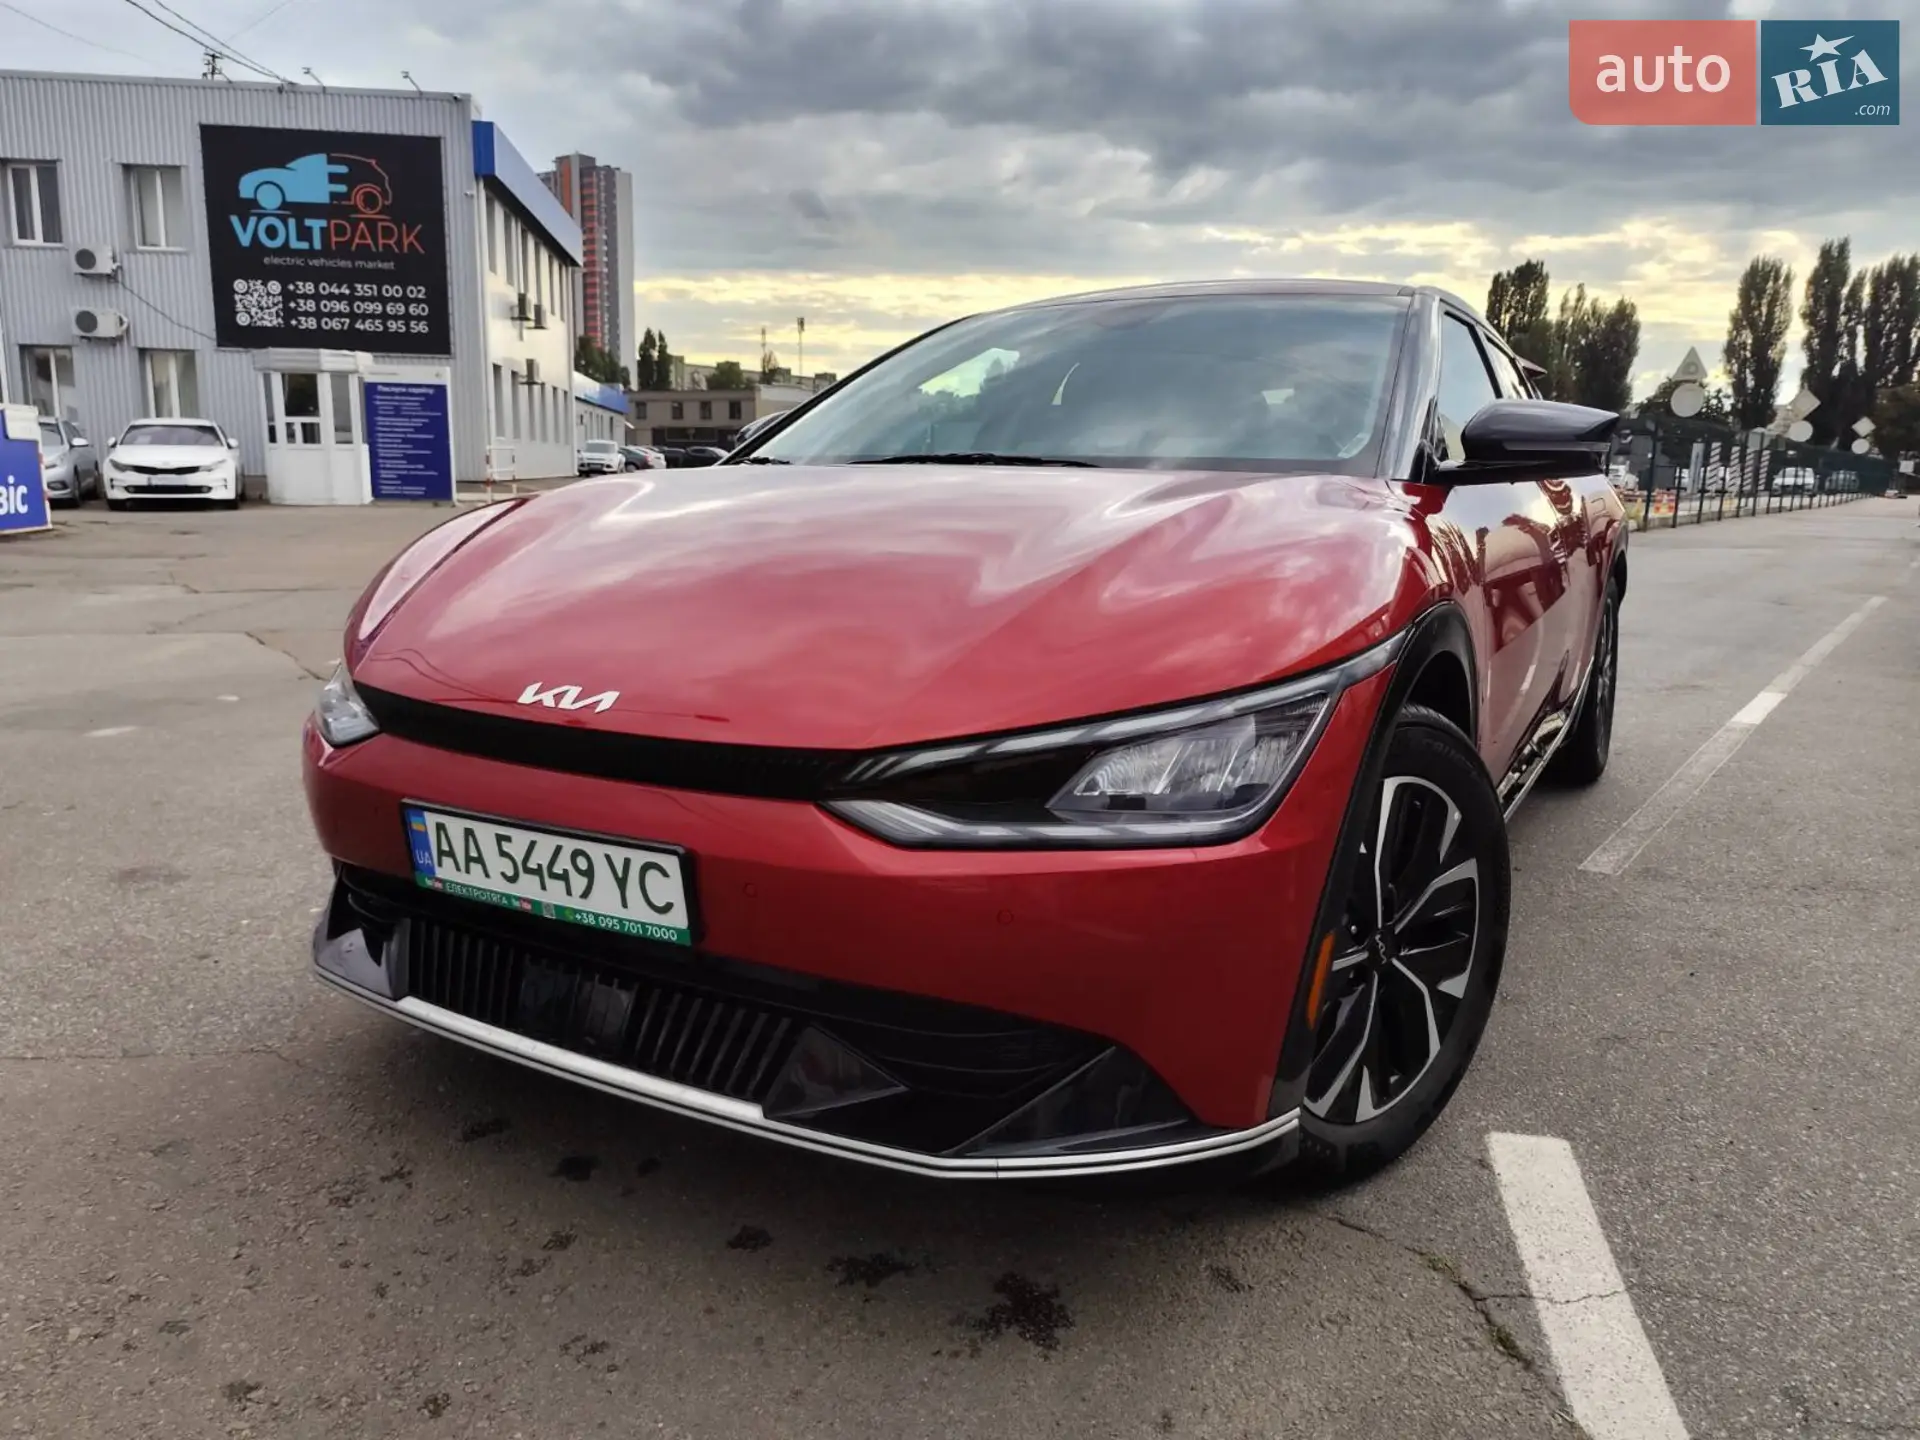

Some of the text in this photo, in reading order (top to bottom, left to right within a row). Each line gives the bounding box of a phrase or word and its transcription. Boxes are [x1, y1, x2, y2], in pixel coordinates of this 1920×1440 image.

[229, 215, 426, 254] VOLTPARK
[263, 255, 396, 270] electric vehicles market
[287, 281, 427, 299] +38 044 351 00 02
[288, 299, 429, 316] +38 096 099 69 60
[290, 316, 429, 333] +38 067 465 95 56
[517, 681, 620, 714] KIA
[415, 850, 432, 867] UA
[494, 832, 595, 900] 5449
[575, 912, 678, 941] +38 095 701 7000
